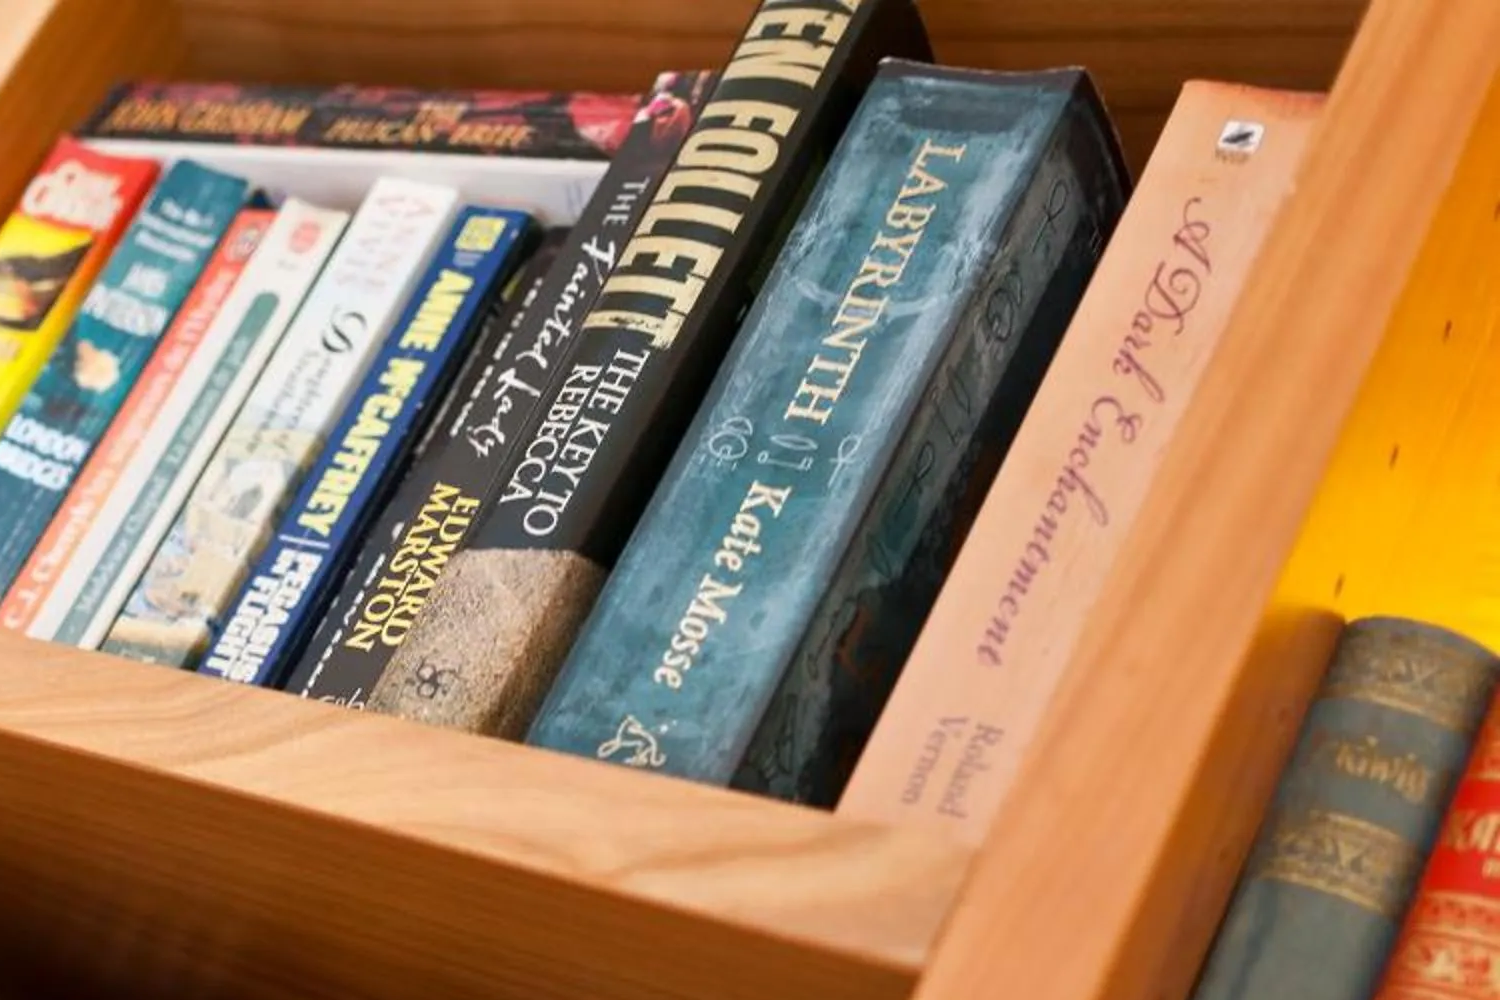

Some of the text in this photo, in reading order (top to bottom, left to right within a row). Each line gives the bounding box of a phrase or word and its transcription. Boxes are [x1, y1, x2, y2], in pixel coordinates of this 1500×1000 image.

[583, 0, 858, 350] EN FOLLETT
[601, 180, 649, 227] THE
[398, 269, 473, 353] ANNE
[516, 241, 621, 370] Tainted
[782, 138, 966, 426] LABYRINTH
[467, 369, 538, 457] Lady
[494, 363, 605, 500] REBECCA
[517, 348, 651, 538] THE KEY TO
[975, 198, 1209, 667] A Dark Enchantment
[344, 483, 459, 652] MARSTON
[381, 496, 480, 647] EDWARD
[652, 480, 792, 691] Kate Mosse
